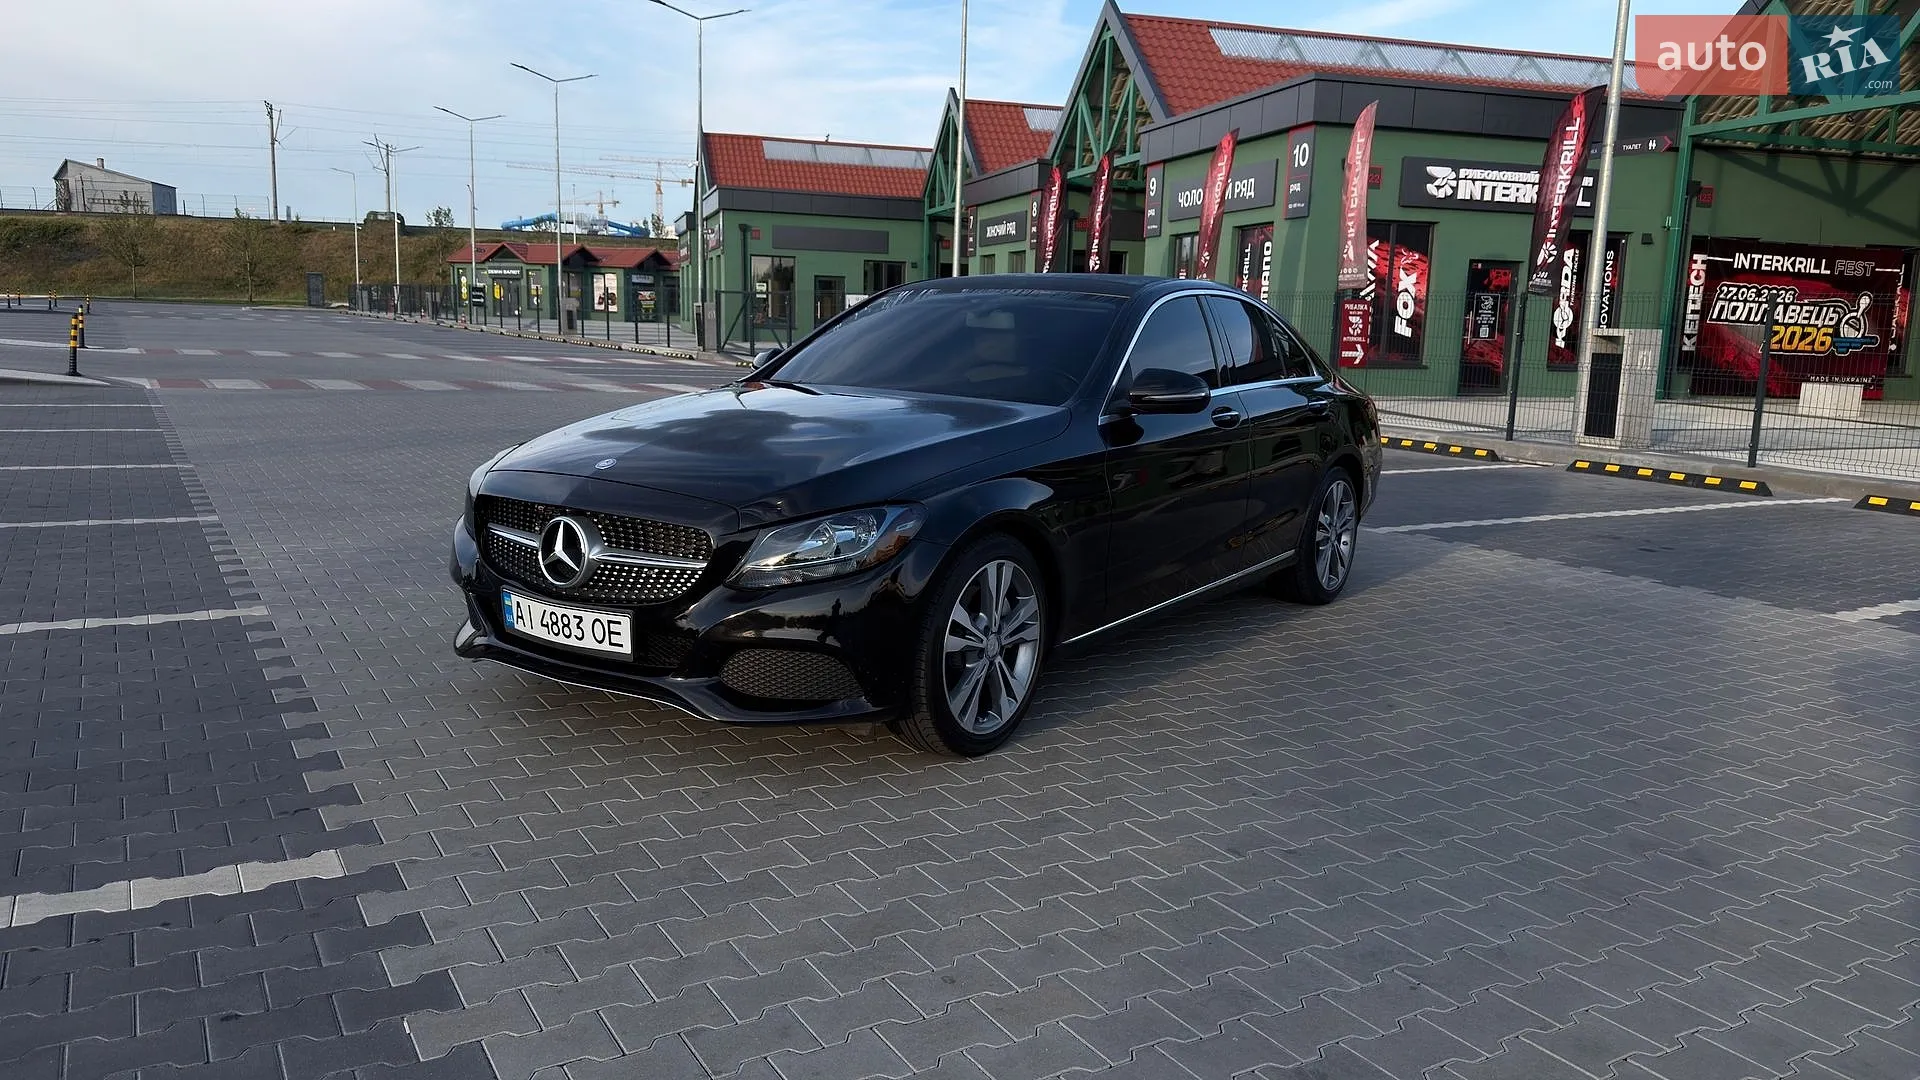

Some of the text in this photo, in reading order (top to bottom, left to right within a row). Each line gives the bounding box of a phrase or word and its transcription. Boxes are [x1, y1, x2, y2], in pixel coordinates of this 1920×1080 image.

[1293, 142, 1310, 168] 10
[1149, 177, 1157, 197] 9
[1546, 116, 1581, 239] INTERKRILL
[1178, 177, 1255, 208] ЧОЛОЙ РЯД
[1456, 179, 1591, 208] INTERKL
[1032, 201, 1038, 217] 8
[1733, 252, 1875, 277] INTERKRILL FEST
[1394, 266, 1418, 338] FOX
[1682, 253, 1709, 351] KEITECH
[1769, 325, 1834, 352] 2026
[516, 600, 624, 648] AI 4883 OE
